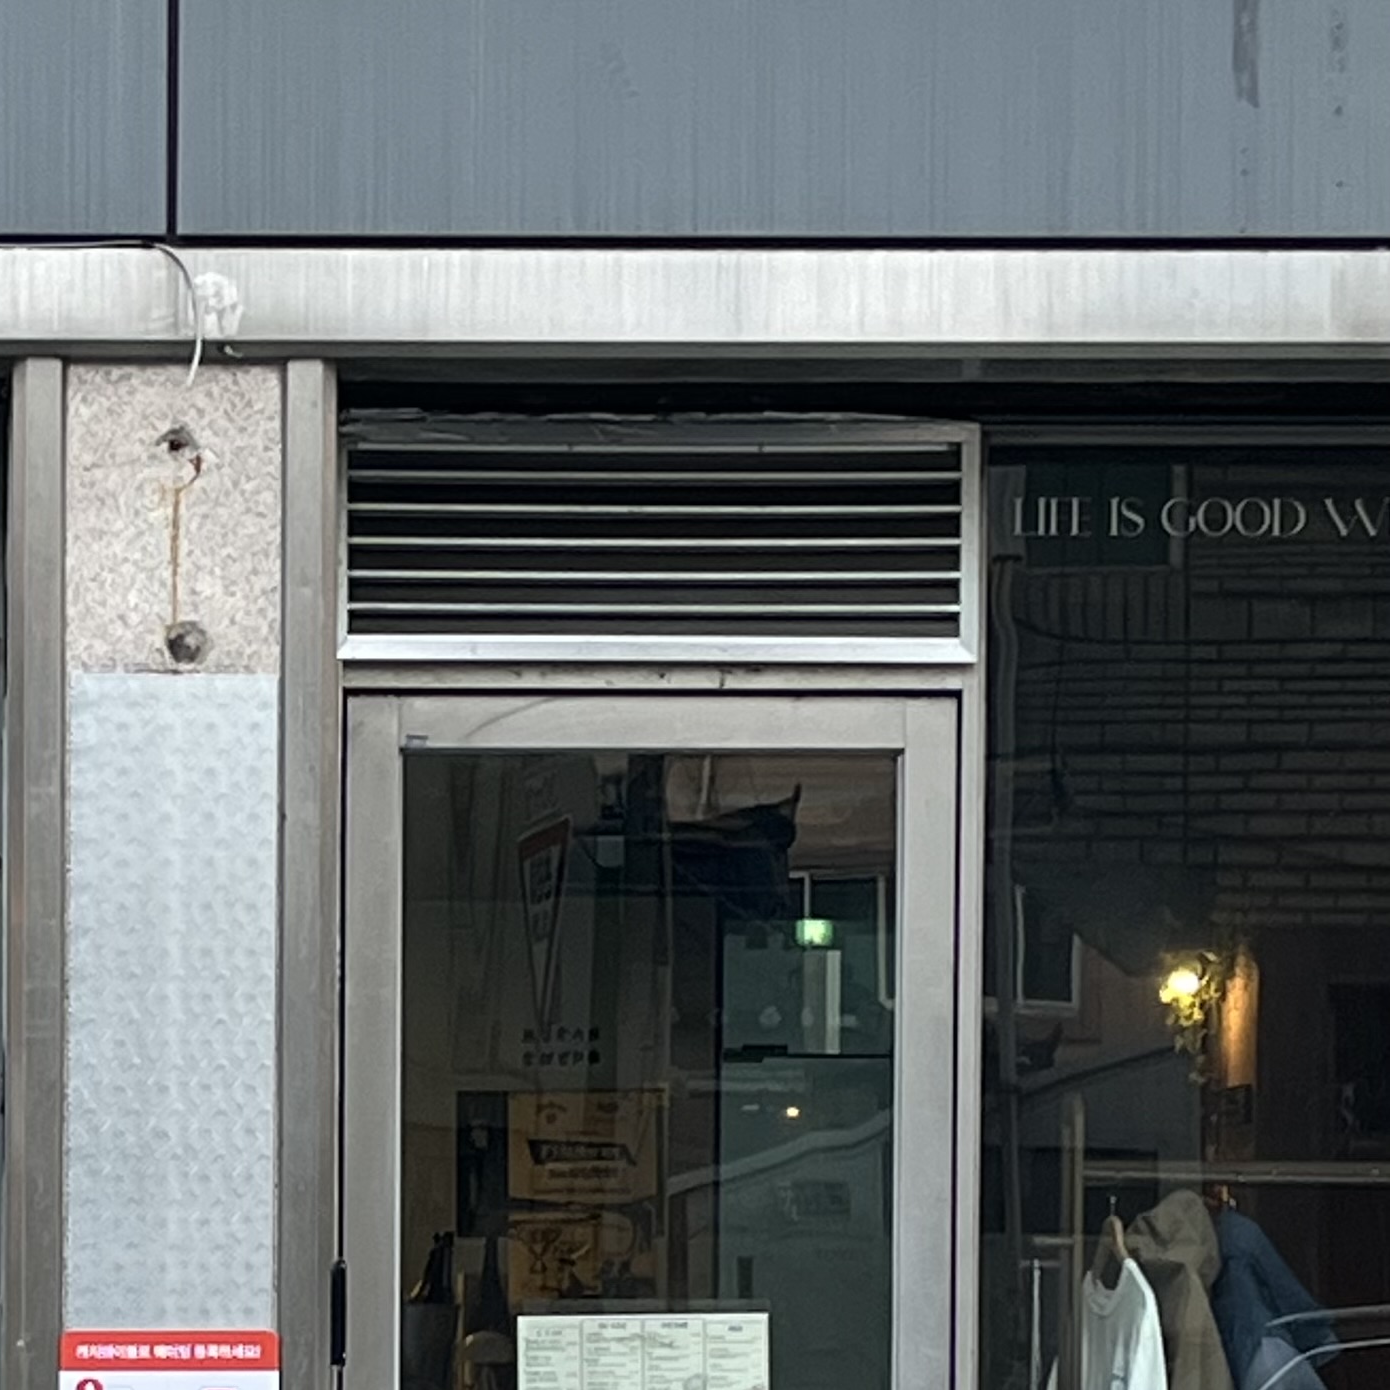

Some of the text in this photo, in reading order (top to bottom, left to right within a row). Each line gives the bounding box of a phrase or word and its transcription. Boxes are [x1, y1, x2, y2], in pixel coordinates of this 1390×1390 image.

[1013, 497, 1092, 537] LIFE
[1109, 497, 1145, 537] IS
[1160, 497, 1306, 538] GOOD
